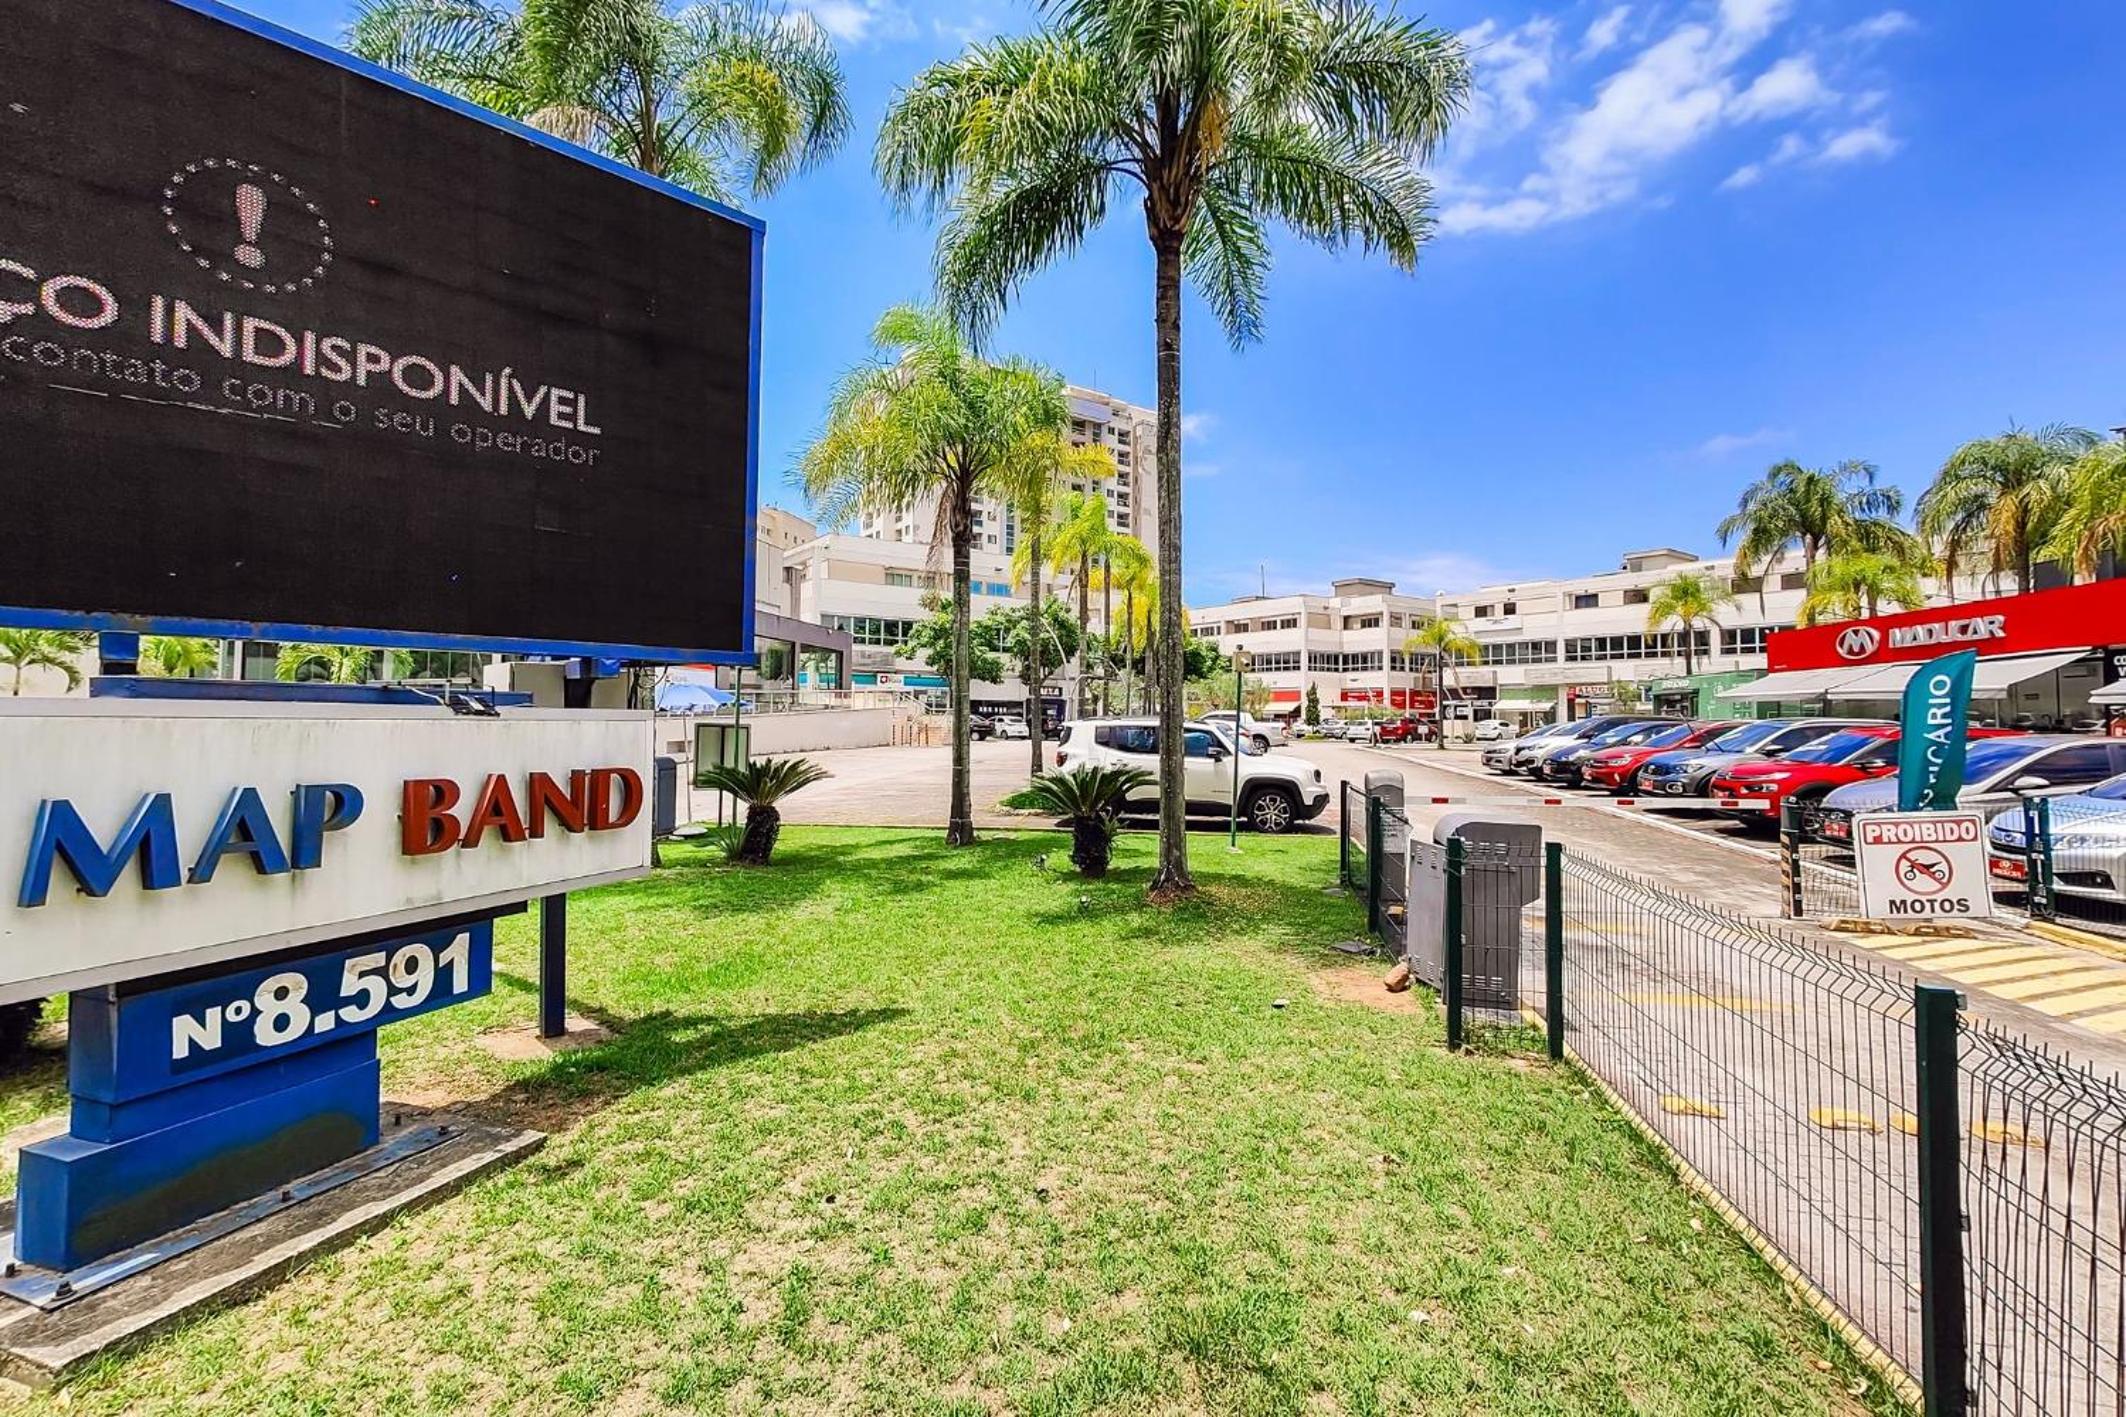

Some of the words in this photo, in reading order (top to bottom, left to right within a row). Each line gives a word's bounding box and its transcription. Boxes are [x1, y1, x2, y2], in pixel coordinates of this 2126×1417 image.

[2, 336, 201, 392] contato
[222, 378, 315, 415] com
[333, 401, 357, 422] o
[375, 408, 434, 437] seu
[450, 423, 600, 466] operador
[150, 294, 601, 435] INDISPONÍVEL
[1889, 615, 2006, 648] MADUCAR
[17, 783, 365, 908] MAP
[402, 767, 643, 856] BAND
[1865, 821, 1977, 844] PROIBIDO
[1889, 898, 1971, 915] MOTOS
